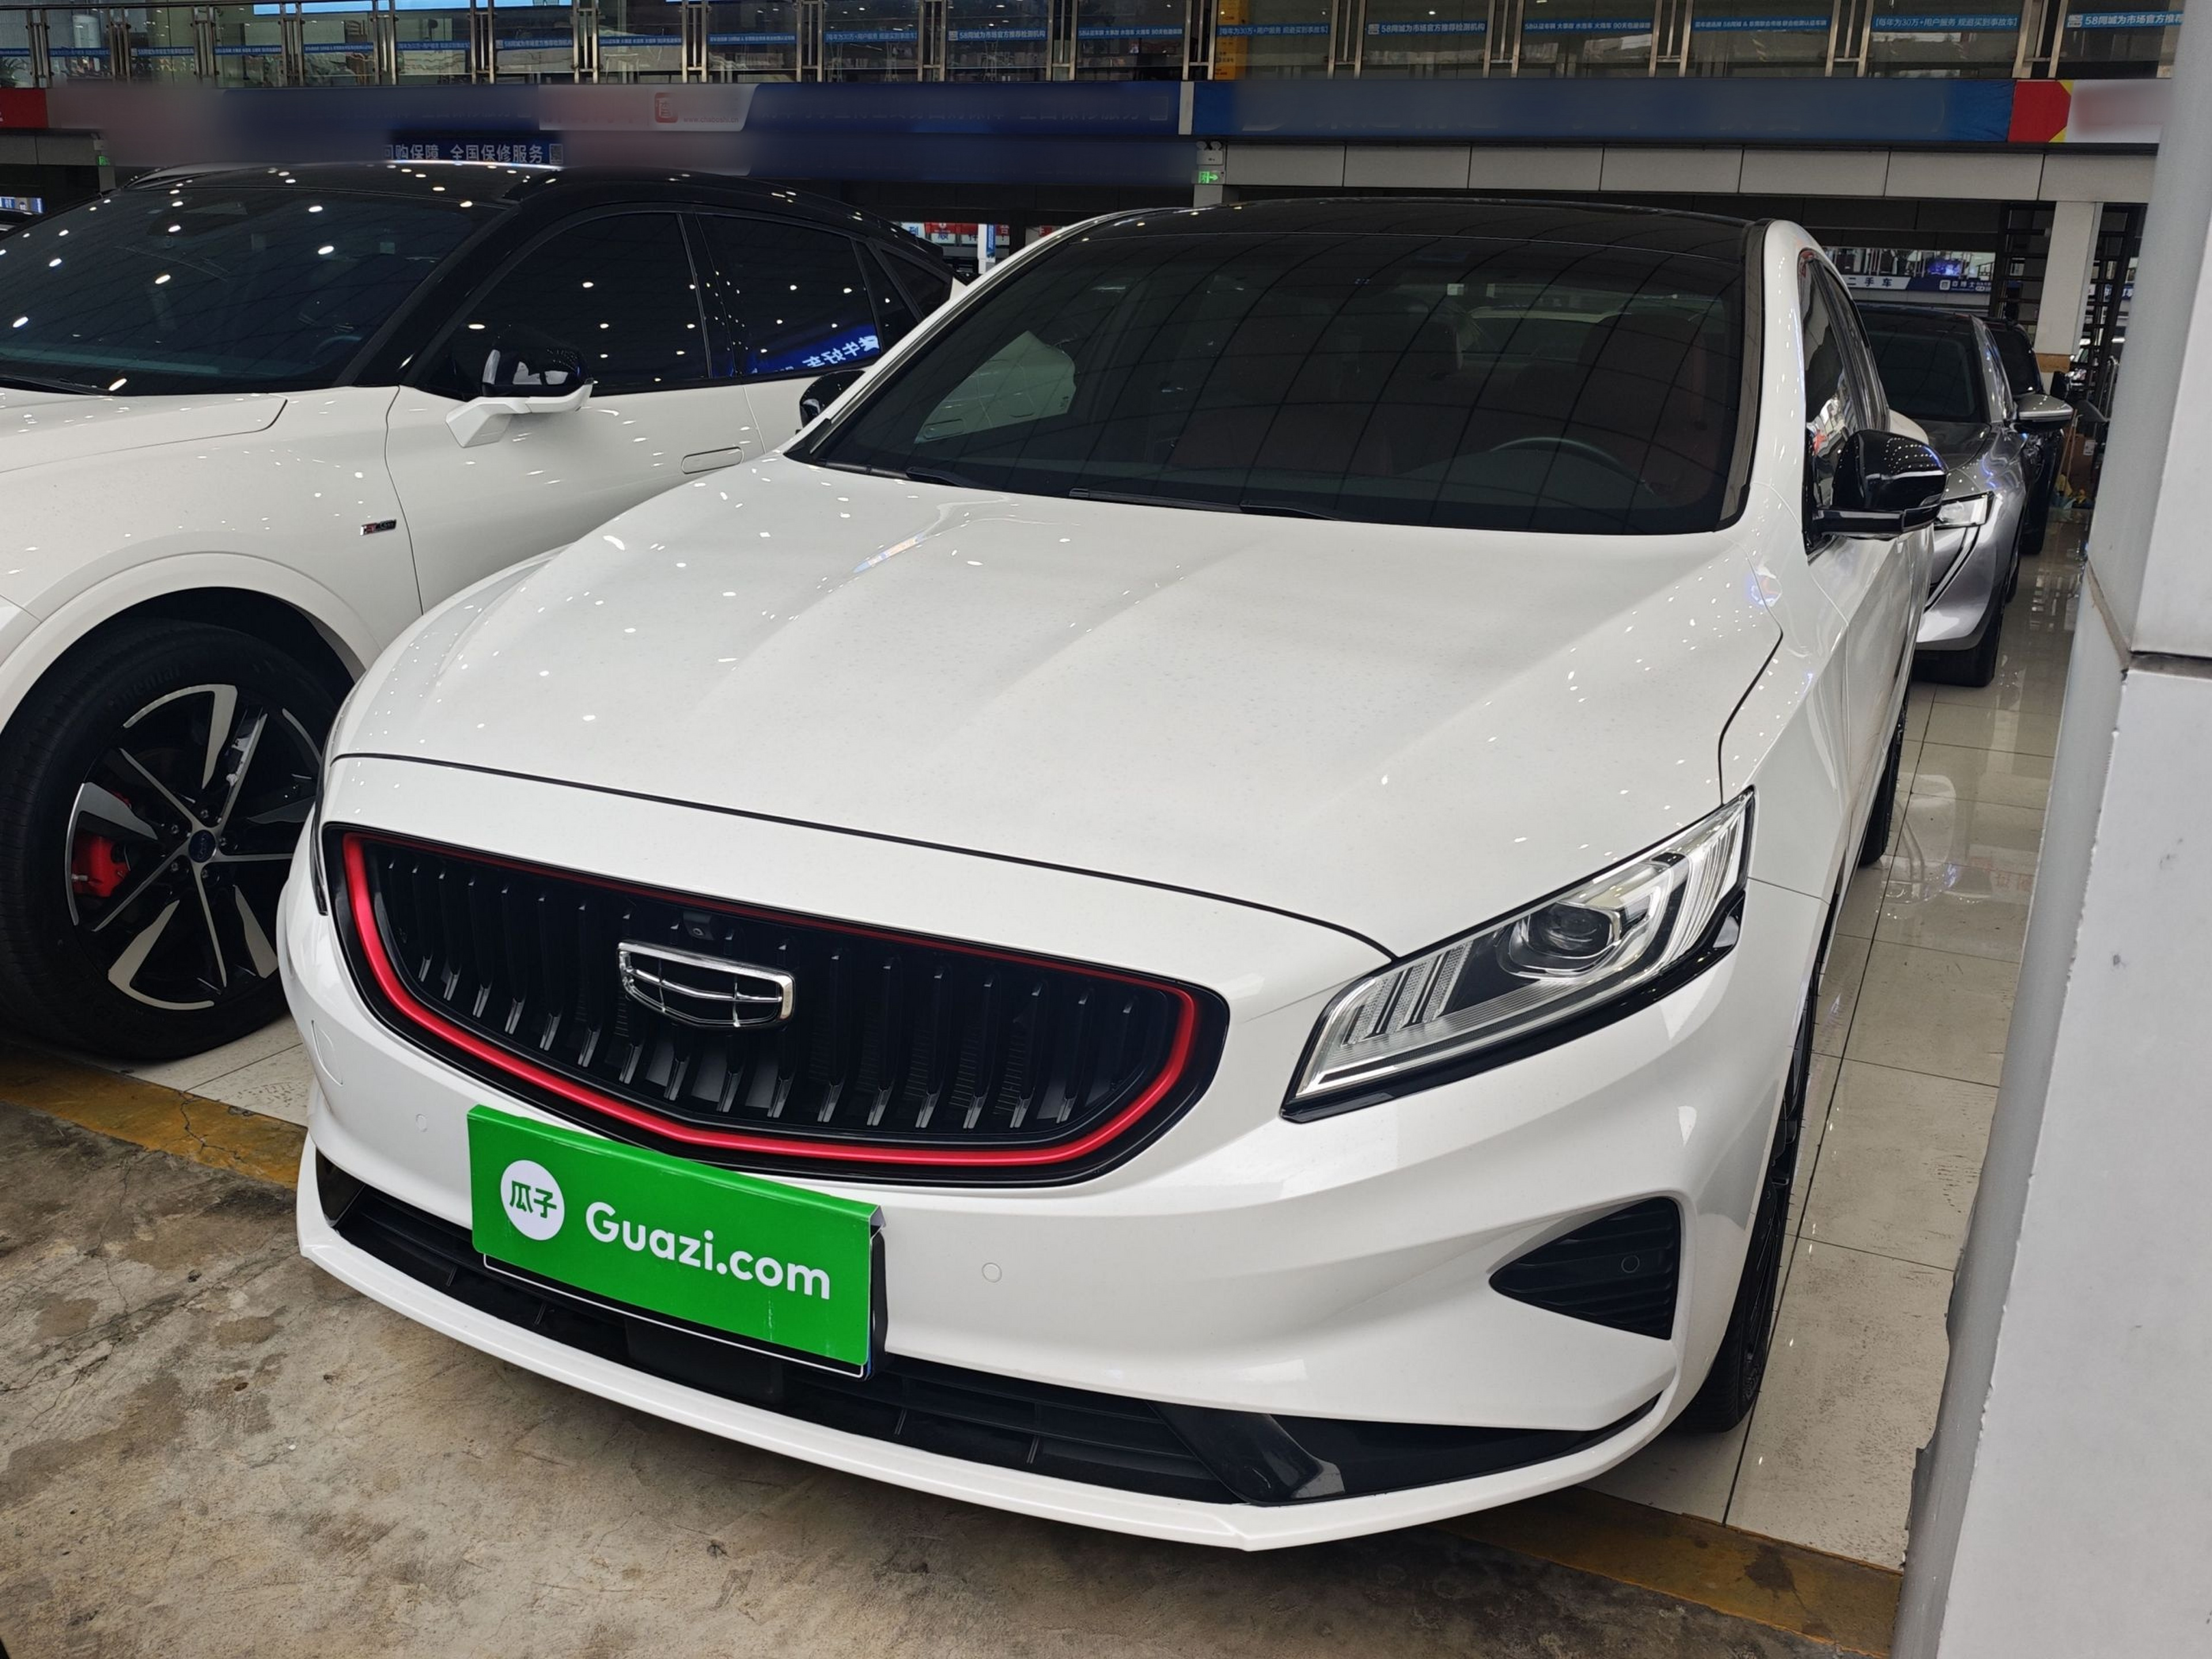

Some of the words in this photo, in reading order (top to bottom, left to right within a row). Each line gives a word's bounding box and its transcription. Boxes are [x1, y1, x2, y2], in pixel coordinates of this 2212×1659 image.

[450, 144, 543, 164] 全国保修服务
[509, 1180, 557, 1218] 瓜子
[585, 1202, 830, 1300] Guazi.com
